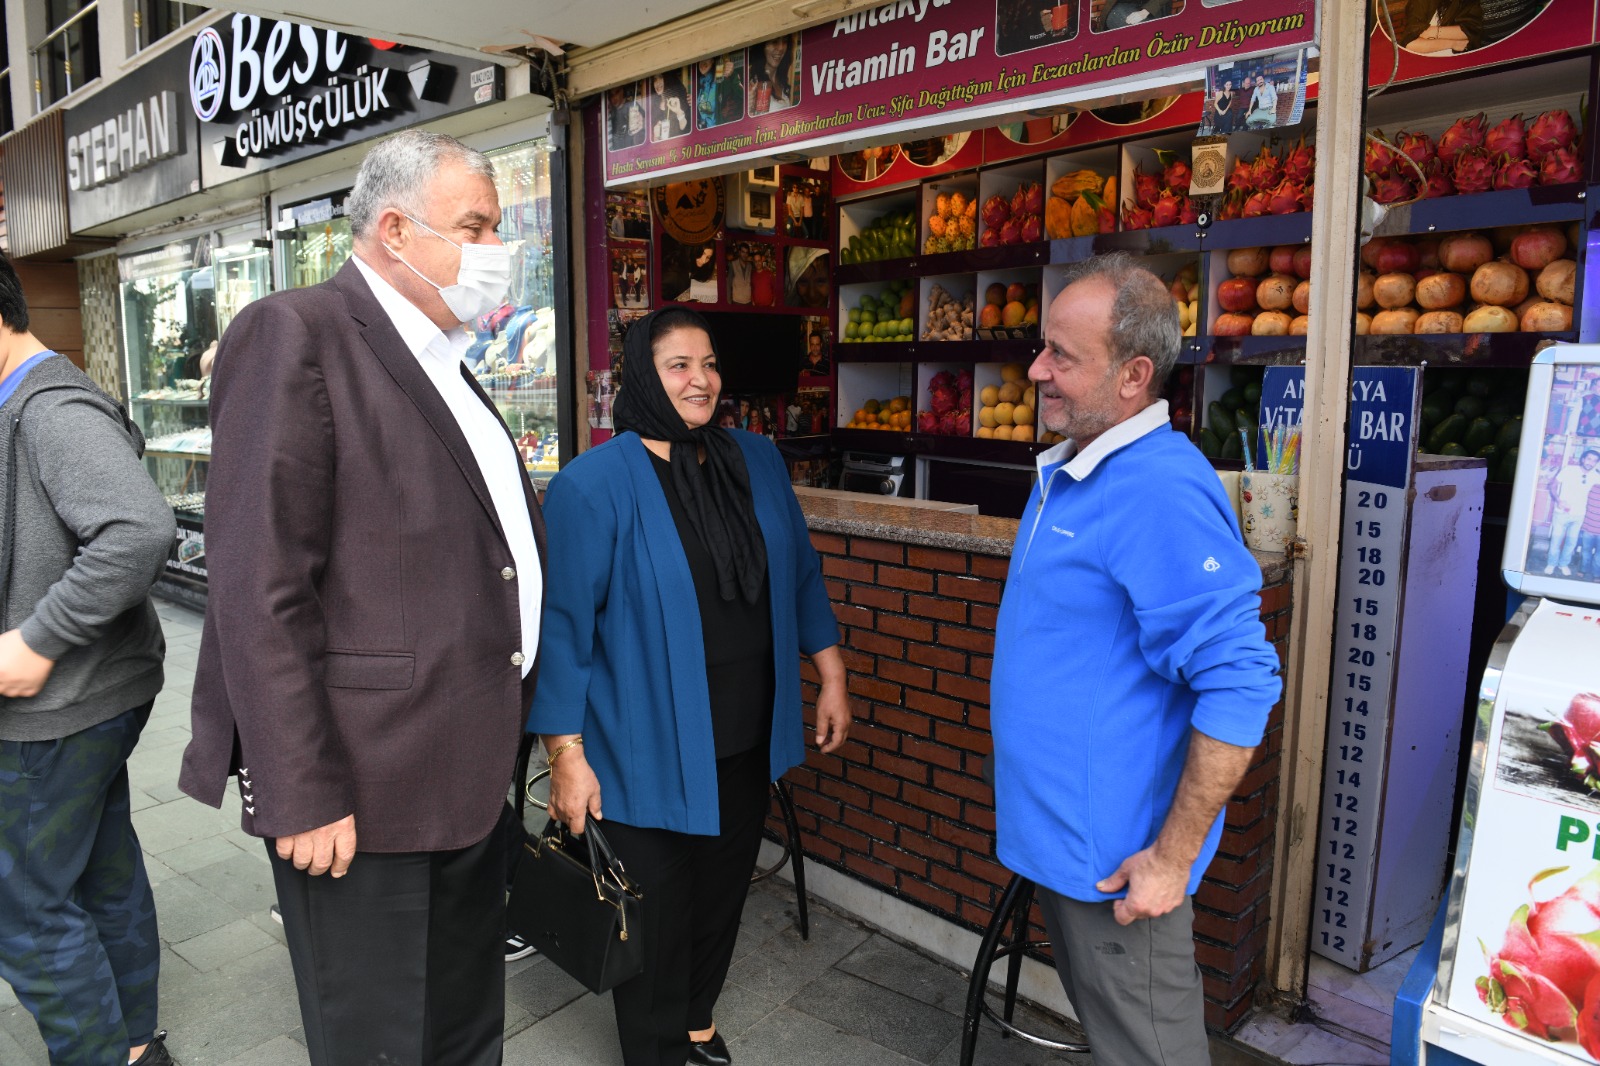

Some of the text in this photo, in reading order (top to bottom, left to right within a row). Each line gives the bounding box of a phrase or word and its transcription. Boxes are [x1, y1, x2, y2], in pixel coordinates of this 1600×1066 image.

[811, 26, 985, 96] Vitamin Bar
[611, 161, 634, 176] Hasta
[669, 149, 678, 163] %
[681, 145, 692, 161] 50
[693, 134, 753, 158] Düşürdüğüm
[755, 126, 777, 145] İçin;
[780, 110, 853, 138] Doktorlardan
[857, 103, 886, 121] Ucuz
[889, 94, 914, 117] Şifa
[918, 79, 993, 109] Dağıttığım
[997, 67, 1027, 93] İçin
[1030, 49, 1141, 84] Eczacılardan
[1147, 31, 1194, 58] Özür
[1197, 12, 1305, 48] Diliyorum
[236, 64, 390, 157] GÜMÜŞÇÜLÜK
[67, 90, 178, 191] STEPHAN
[1359, 411, 1405, 442] BAR
[1358, 491, 1387, 509] 20
[1355, 520, 1381, 538] 15
[1357, 547, 1382, 565] 18
[1358, 569, 1385, 586] 20
[1353, 598, 1378, 616] 15
[1351, 623, 1376, 641] 18
[1349, 648, 1375, 667] 20
[1347, 673, 1371, 692] 15
[1345, 698, 1368, 717] 14
[1342, 721, 1366, 741] 15
[1340, 746, 1363, 763] 12
[1337, 770, 1360, 788] 14
[1335, 793, 1358, 813] 12
[1332, 817, 1357, 836] 12
[1329, 841, 1355, 860] 12
[1327, 864, 1351, 884] 12
[1325, 887, 1348, 907] 12
[1323, 909, 1347, 928] 12
[1321, 932, 1345, 952] 12
